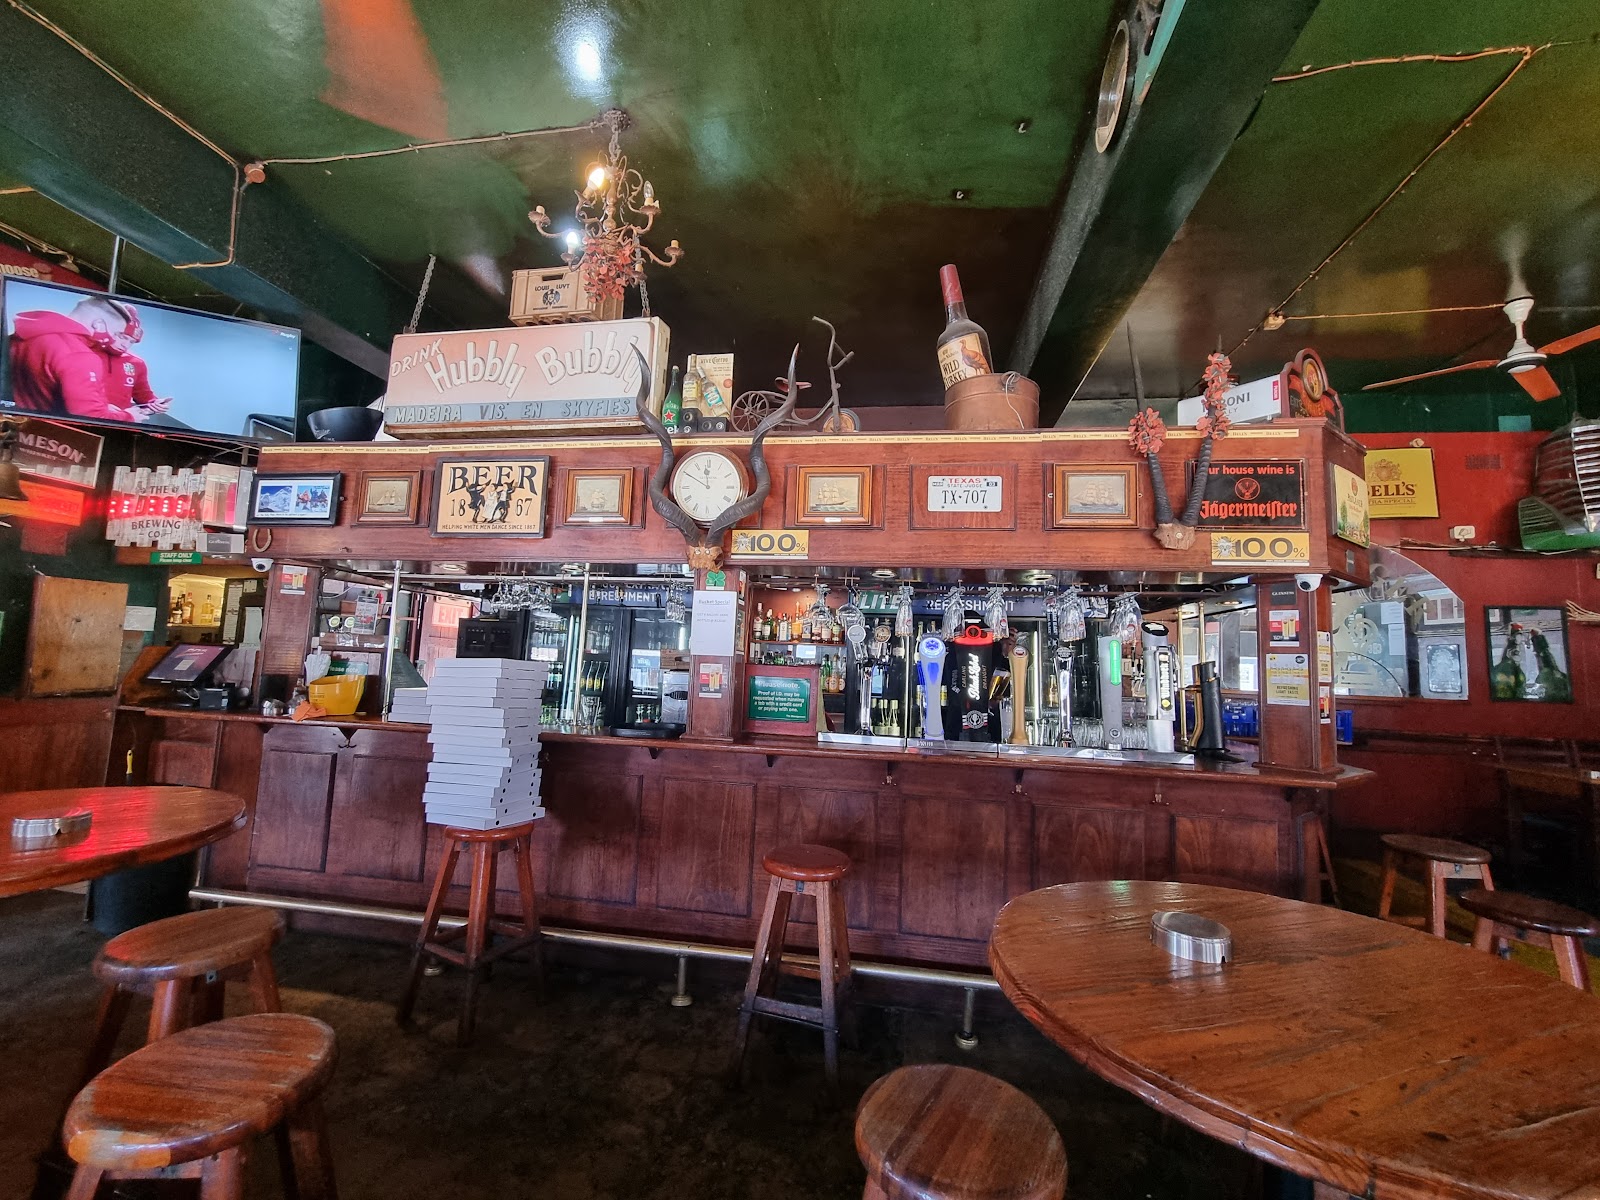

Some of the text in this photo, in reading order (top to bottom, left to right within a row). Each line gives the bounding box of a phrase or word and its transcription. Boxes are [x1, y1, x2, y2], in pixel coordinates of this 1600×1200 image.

[390, 337, 443, 378] DRINK
[423, 330, 640, 399] Hubbly Bubbly
[941, 359, 960, 376] WILD
[394, 405, 462, 424] MADEIRA
[521, 402, 543, 419] EN
[561, 398, 631, 418] SKYFIES
[1208, 465, 1295, 475] ur house wine is
[150, 485, 168, 494] THE
[447, 465, 538, 496] BEER
[450, 498, 532, 517] 18 67
[131, 519, 181, 531] BREWING
[859, 594, 903, 610] LITE
